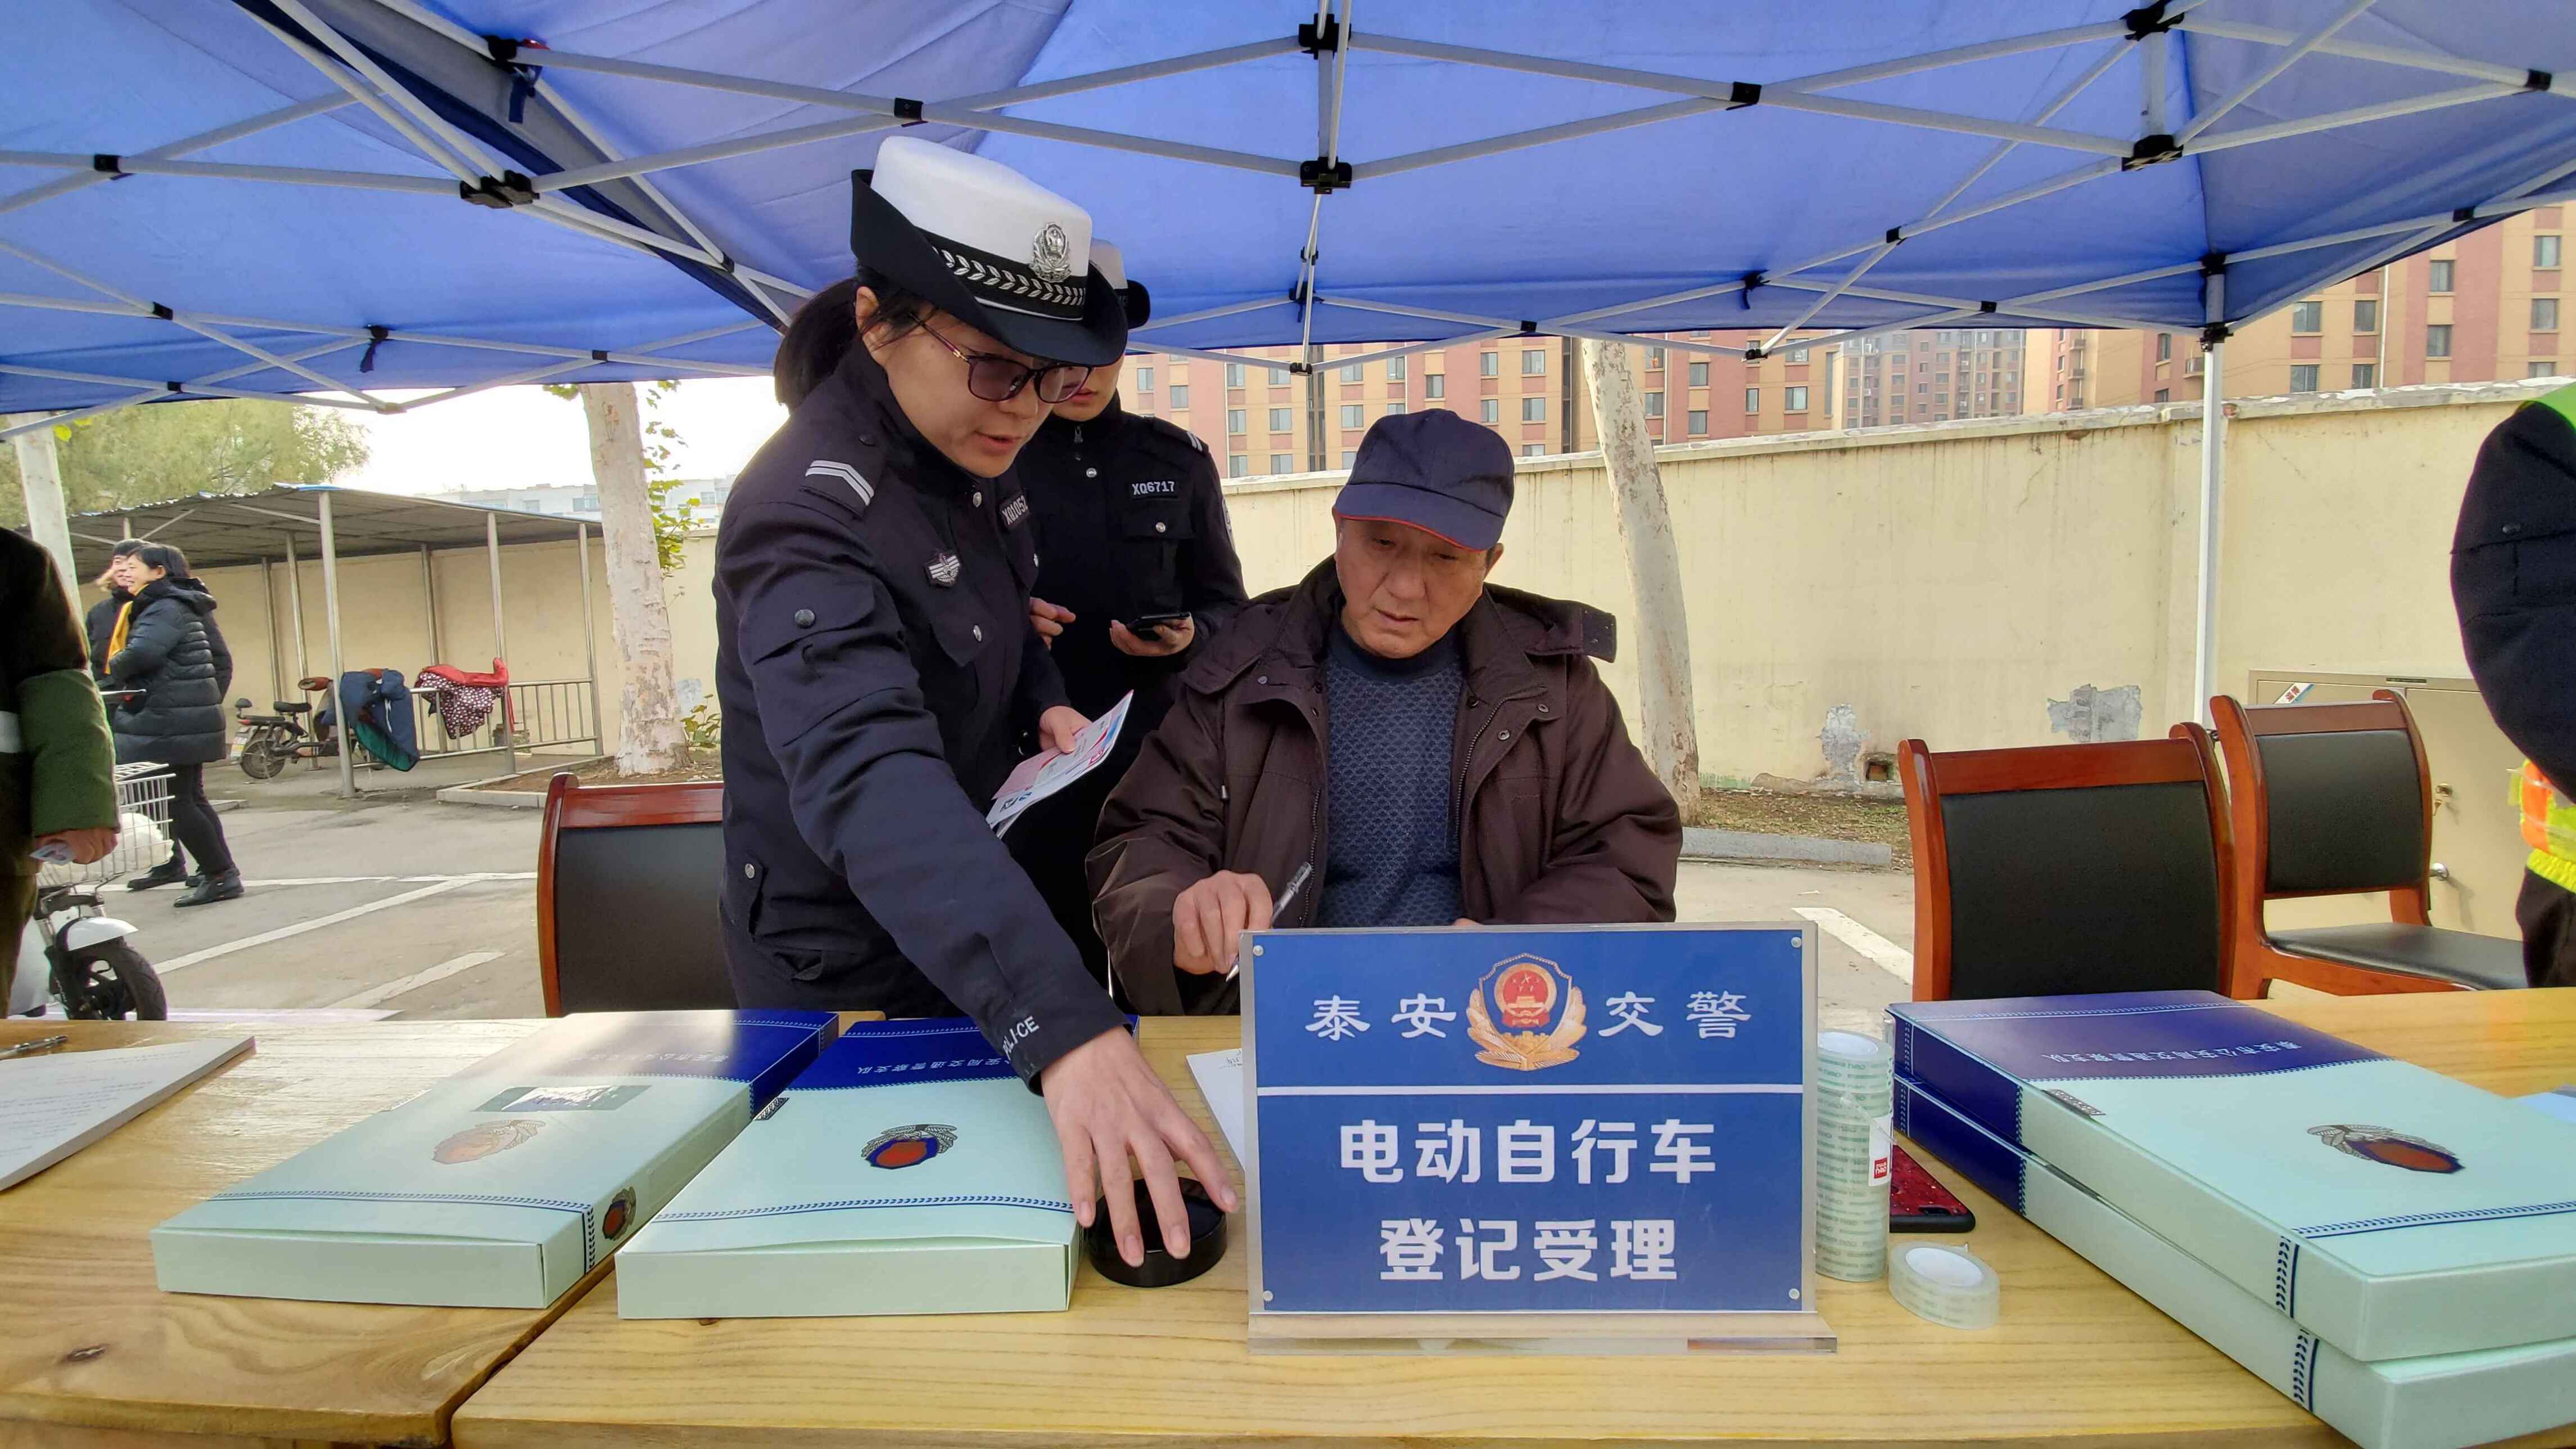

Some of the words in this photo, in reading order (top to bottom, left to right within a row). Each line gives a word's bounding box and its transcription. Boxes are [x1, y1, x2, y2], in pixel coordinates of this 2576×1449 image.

[1132, 481, 1174, 495] XQ6717
[1306, 994, 1456, 1040] 泰安
[1599, 991, 1751, 1038] 交警
[857, 1058, 1010, 1075] 安局交通警察支队
[1341, 1120, 1715, 1184] 电动自行车
[1380, 1218, 1676, 1281] 登记受理
